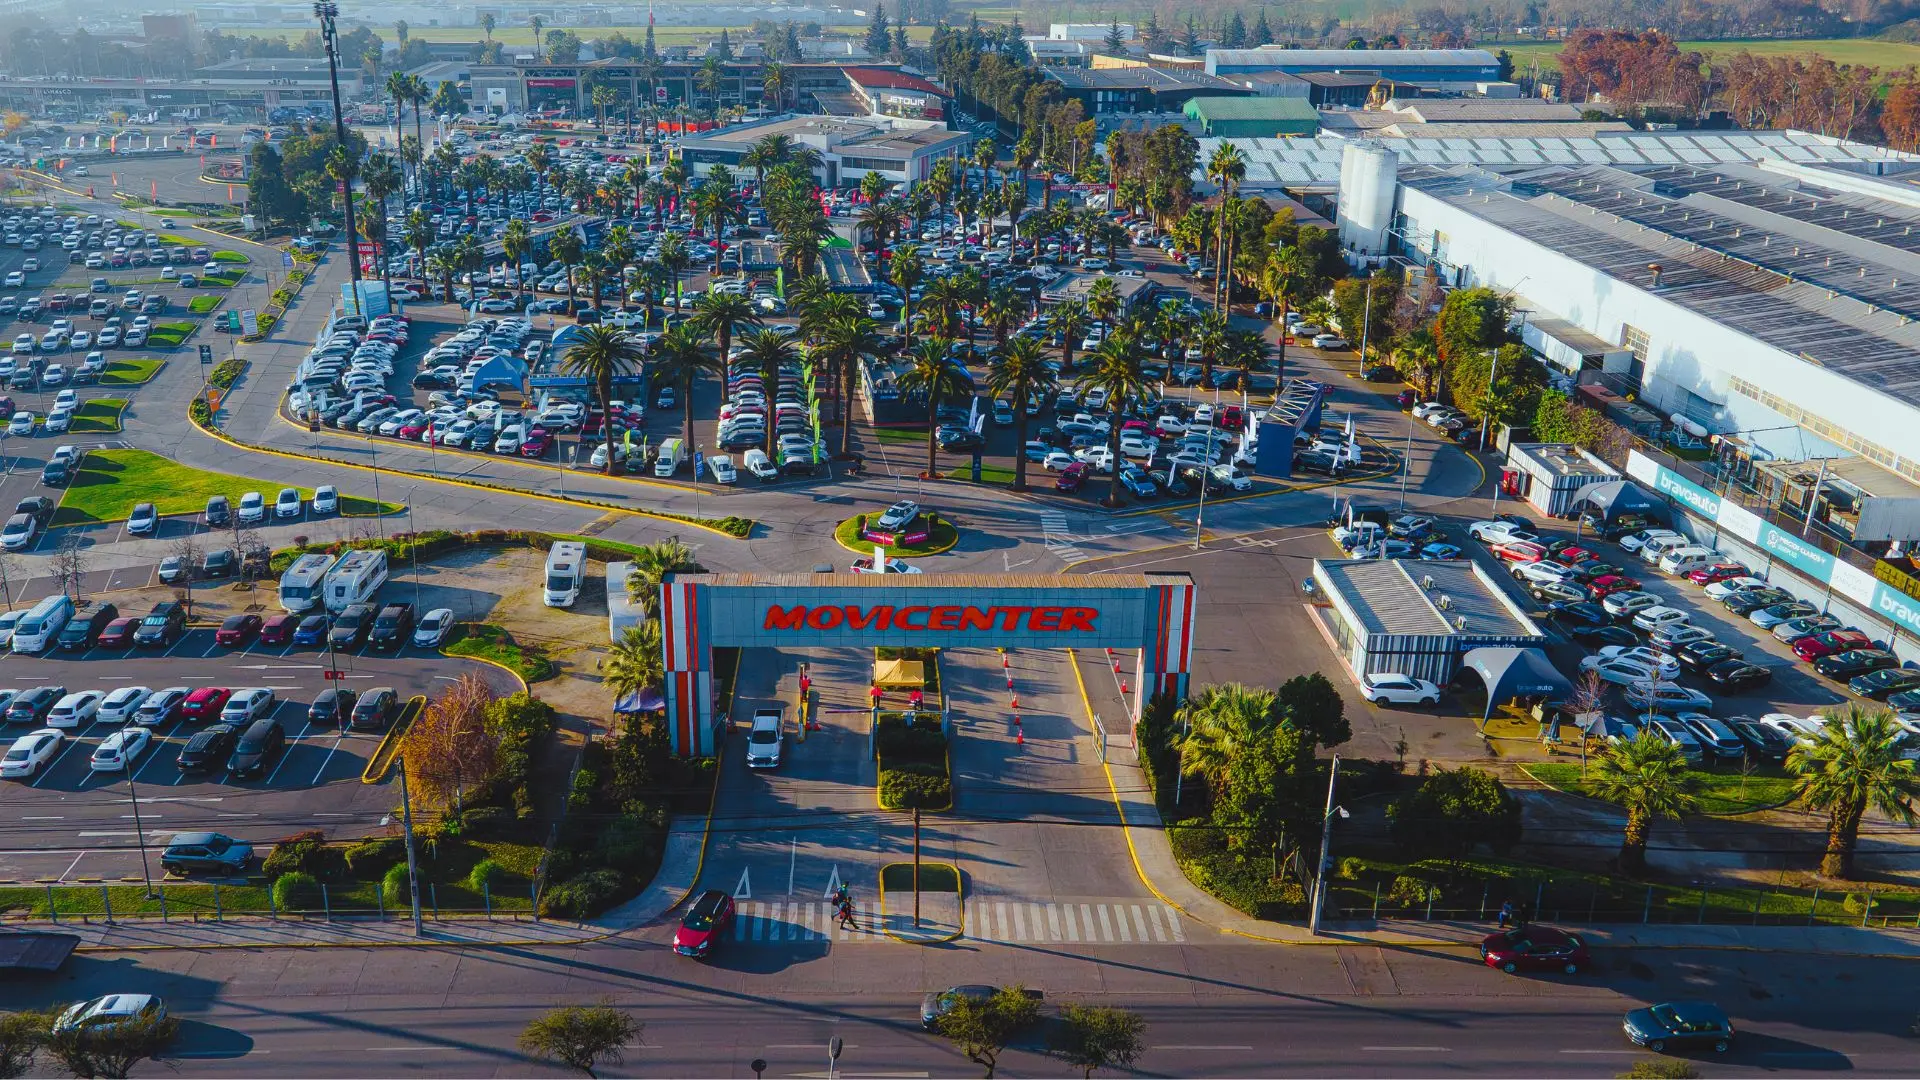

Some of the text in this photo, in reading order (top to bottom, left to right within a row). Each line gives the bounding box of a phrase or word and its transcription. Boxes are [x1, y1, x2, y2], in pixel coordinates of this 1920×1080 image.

[888, 95, 926, 107] JETOUR
[1660, 471, 1718, 515] bravoauto
[763, 604, 1099, 632] MOVICENTER
